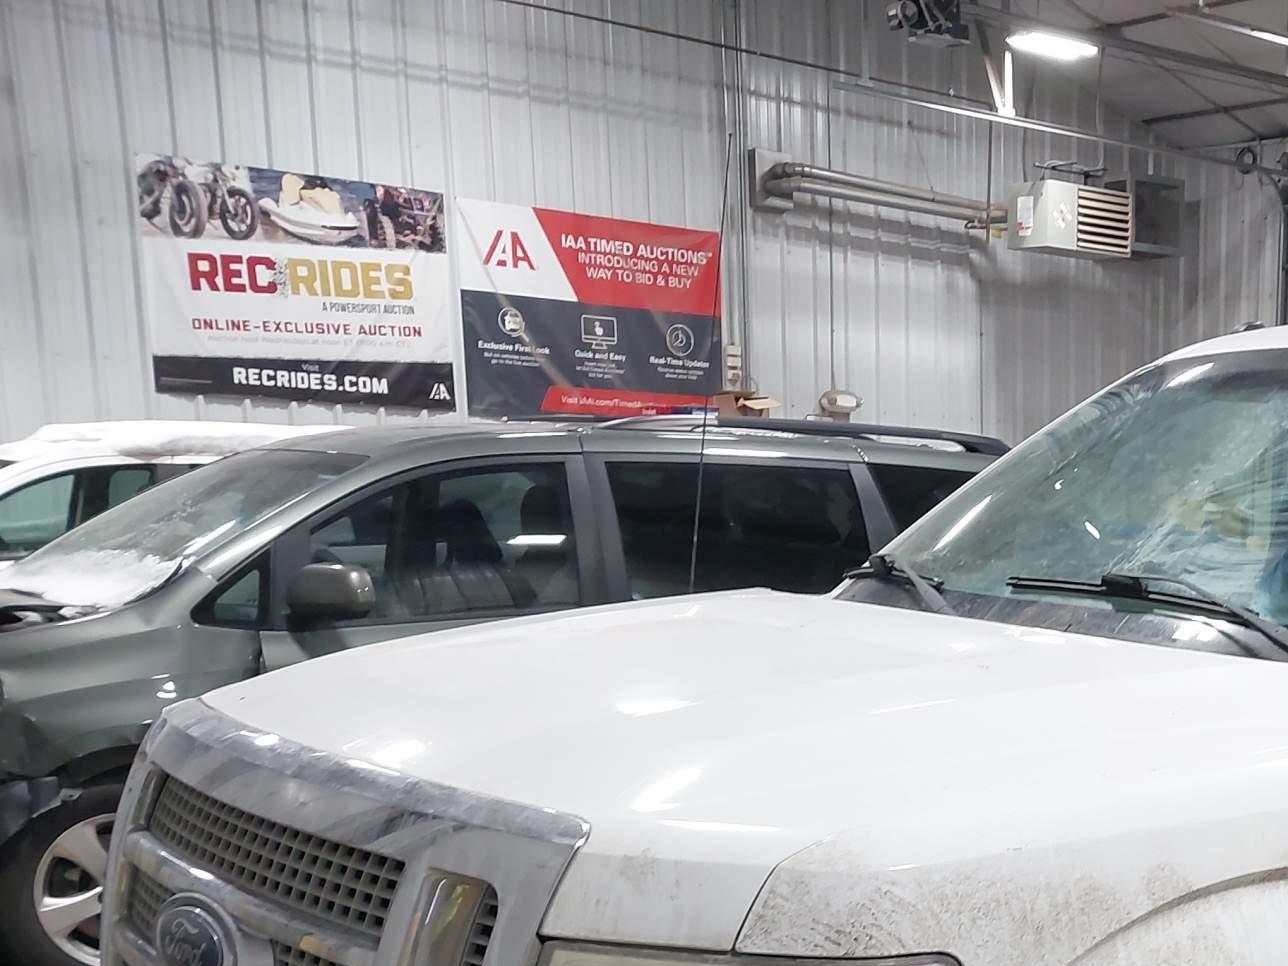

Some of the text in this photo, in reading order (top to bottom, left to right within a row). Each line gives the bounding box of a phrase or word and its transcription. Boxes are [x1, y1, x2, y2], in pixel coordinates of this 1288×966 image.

[560, 232, 586, 250] IAA
[588, 238, 633, 256] TIMED
[578, 252, 699, 277] INTRODUCING A NEW
[188, 252, 414, 300] REC RIDES
[585, 266, 692, 290] WAY TO BID & BUY
[330, 302, 381, 315] POWERSPORT
[383, 304, 415, 316] AUCTION
[192, 318, 423, 337] ONLINE-EXCLUSIVE AUCTION
[477, 340, 514, 352] Exclusive
[574, 350, 627, 362] Quick and Easy
[649, 355, 683, 366] Real-Time
[233, 367, 389, 395] RECRIDES.COM
[560, 394, 580, 405] Visit
